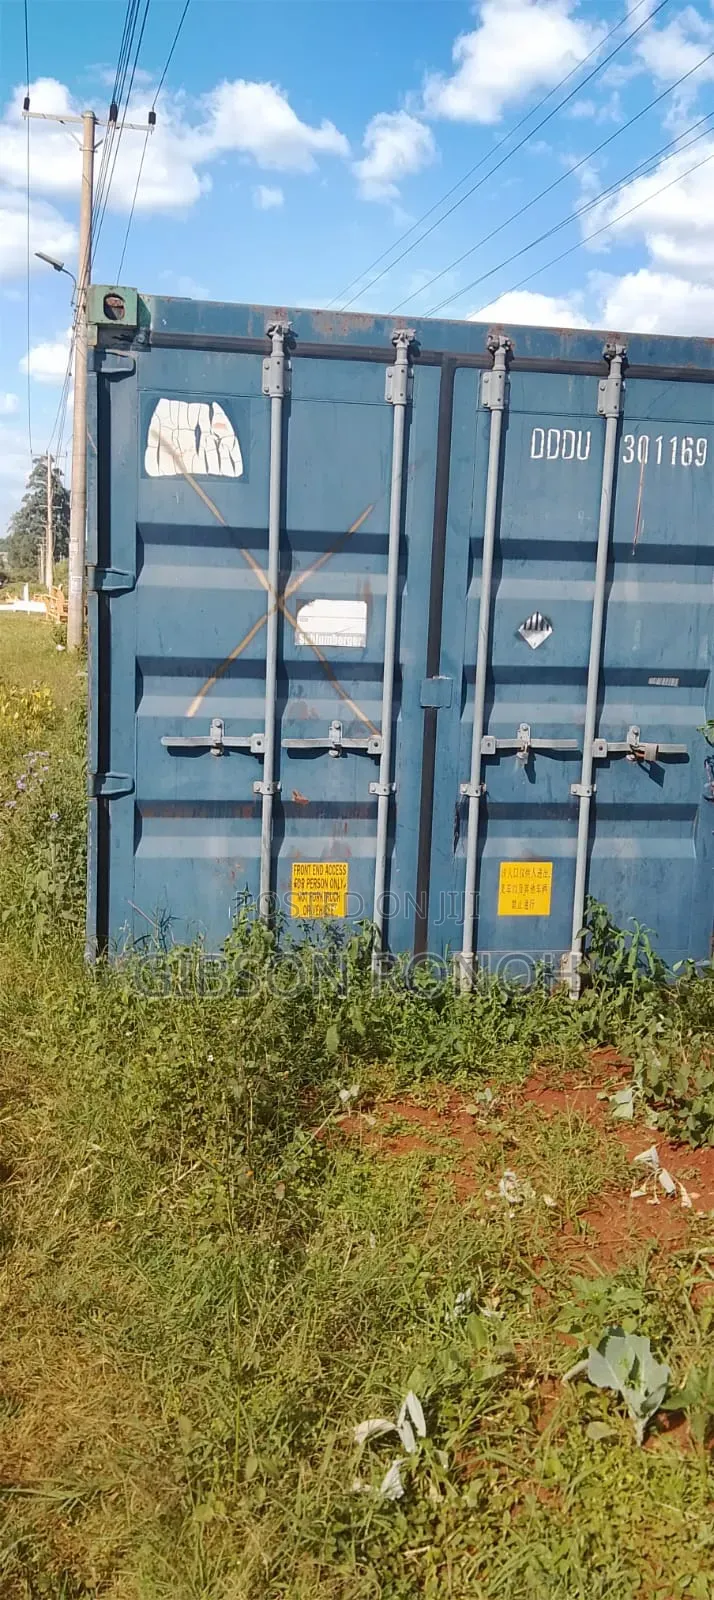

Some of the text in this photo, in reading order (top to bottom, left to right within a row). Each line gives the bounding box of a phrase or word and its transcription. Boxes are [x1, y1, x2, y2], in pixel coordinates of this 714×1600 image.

[530, 428, 708, 467] DDDU 301169
[293, 864, 347, 876] FRONT END ACCESS
[306, 877, 328, 889] PERSON
